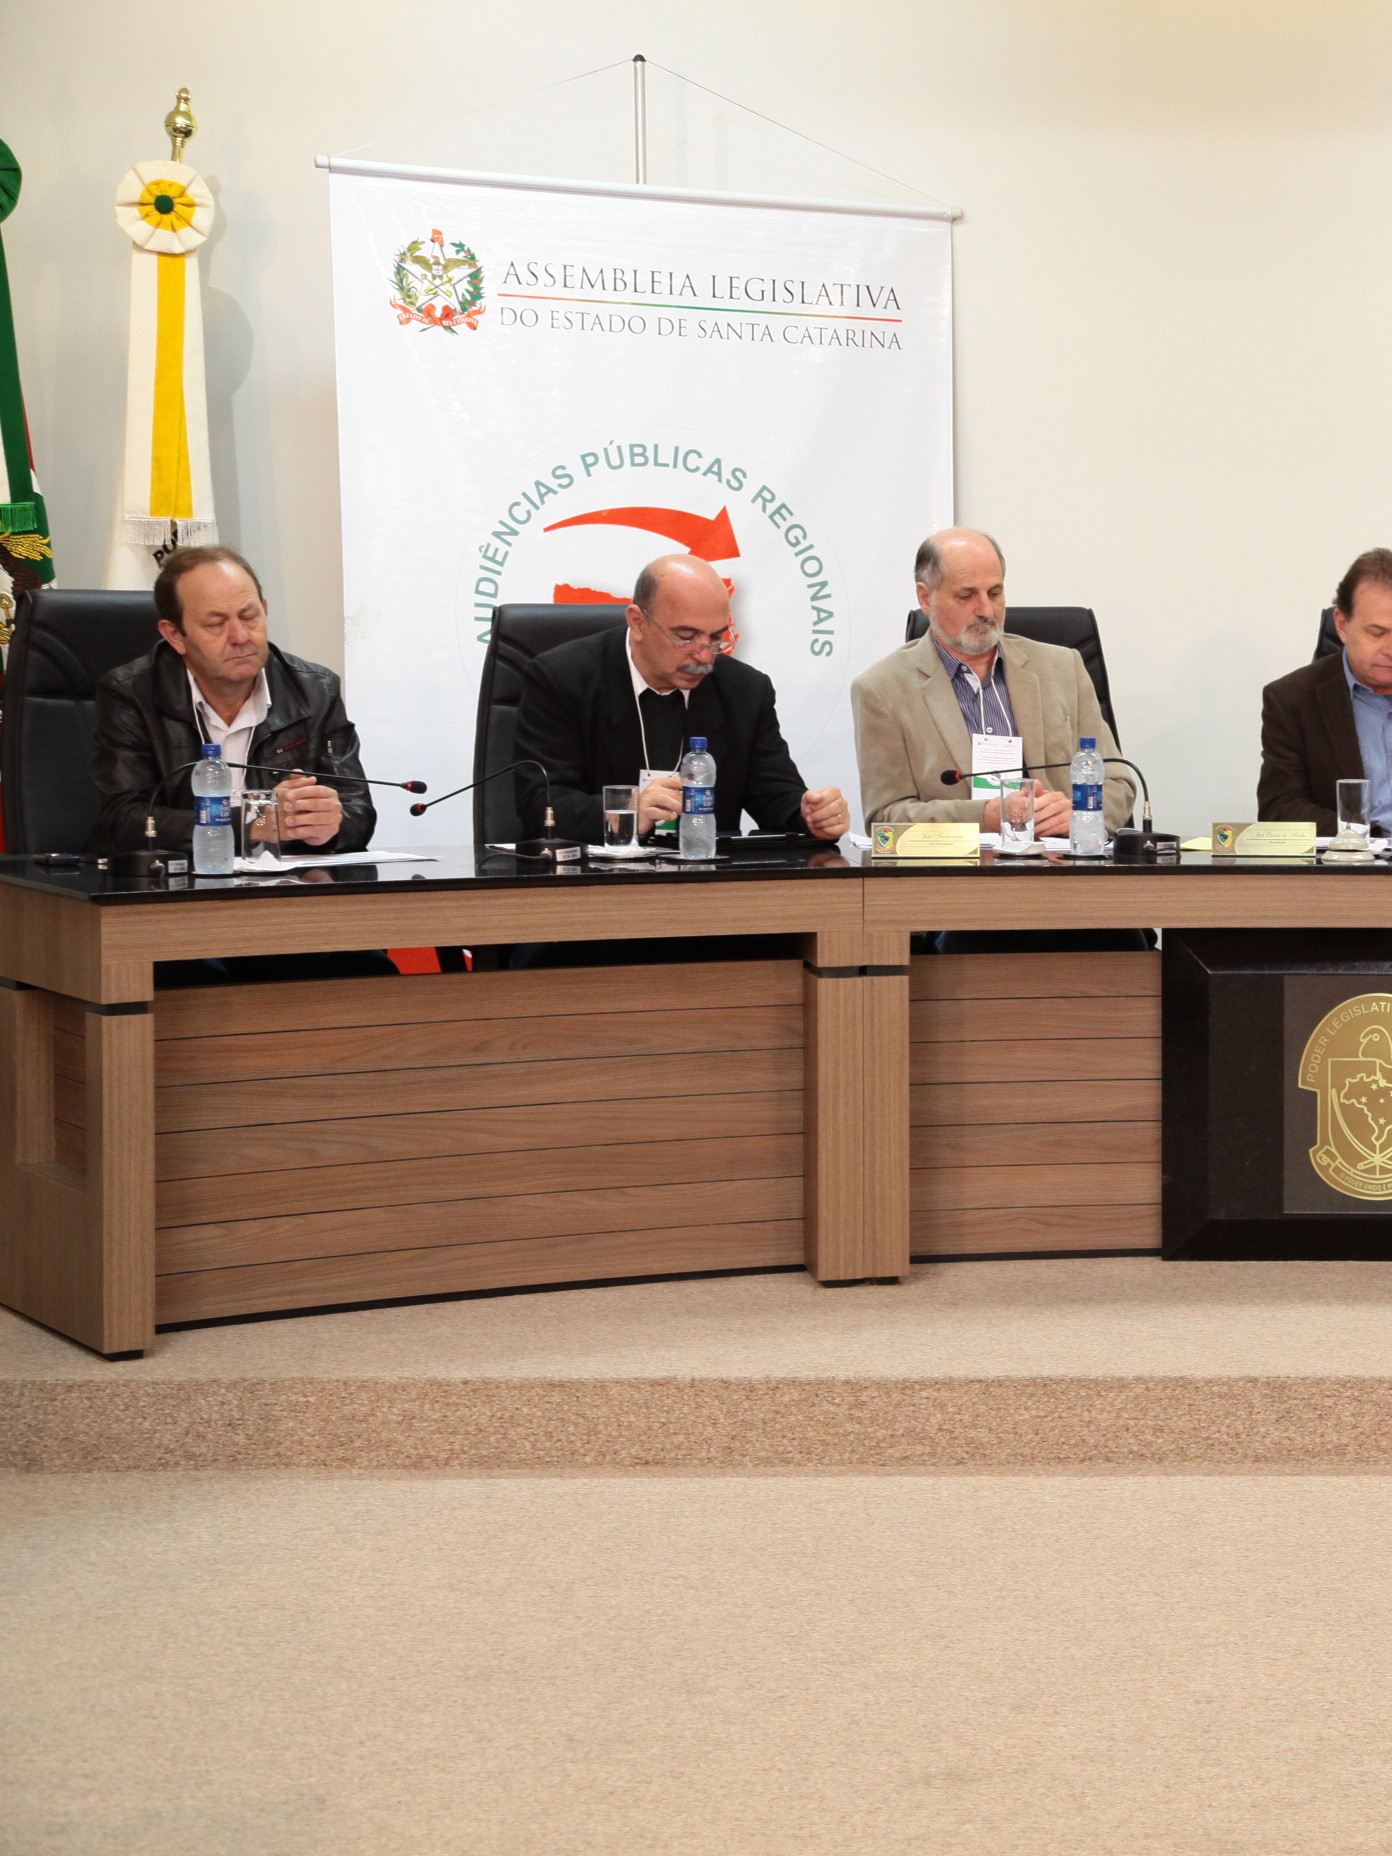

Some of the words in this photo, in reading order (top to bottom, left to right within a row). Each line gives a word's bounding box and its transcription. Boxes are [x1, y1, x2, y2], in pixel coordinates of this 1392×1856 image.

[501, 261, 698, 297] ASSEMBLEIA
[711, 274, 902, 311] LEGISLATIVA
[500, 306, 539, 329] DO
[550, 310, 646, 335] ESTADO
[657, 316, 688, 338] DE
[697, 319, 775, 343] SANTA
[782, 324, 902, 351] CATARINA
[474, 465, 575, 645] AUDIÊNCIAS
[580, 440, 747, 492] PÚBLICAS
[751, 485, 834, 657] REGIONAIS
[1306, 1036, 1330, 1083] PODER
